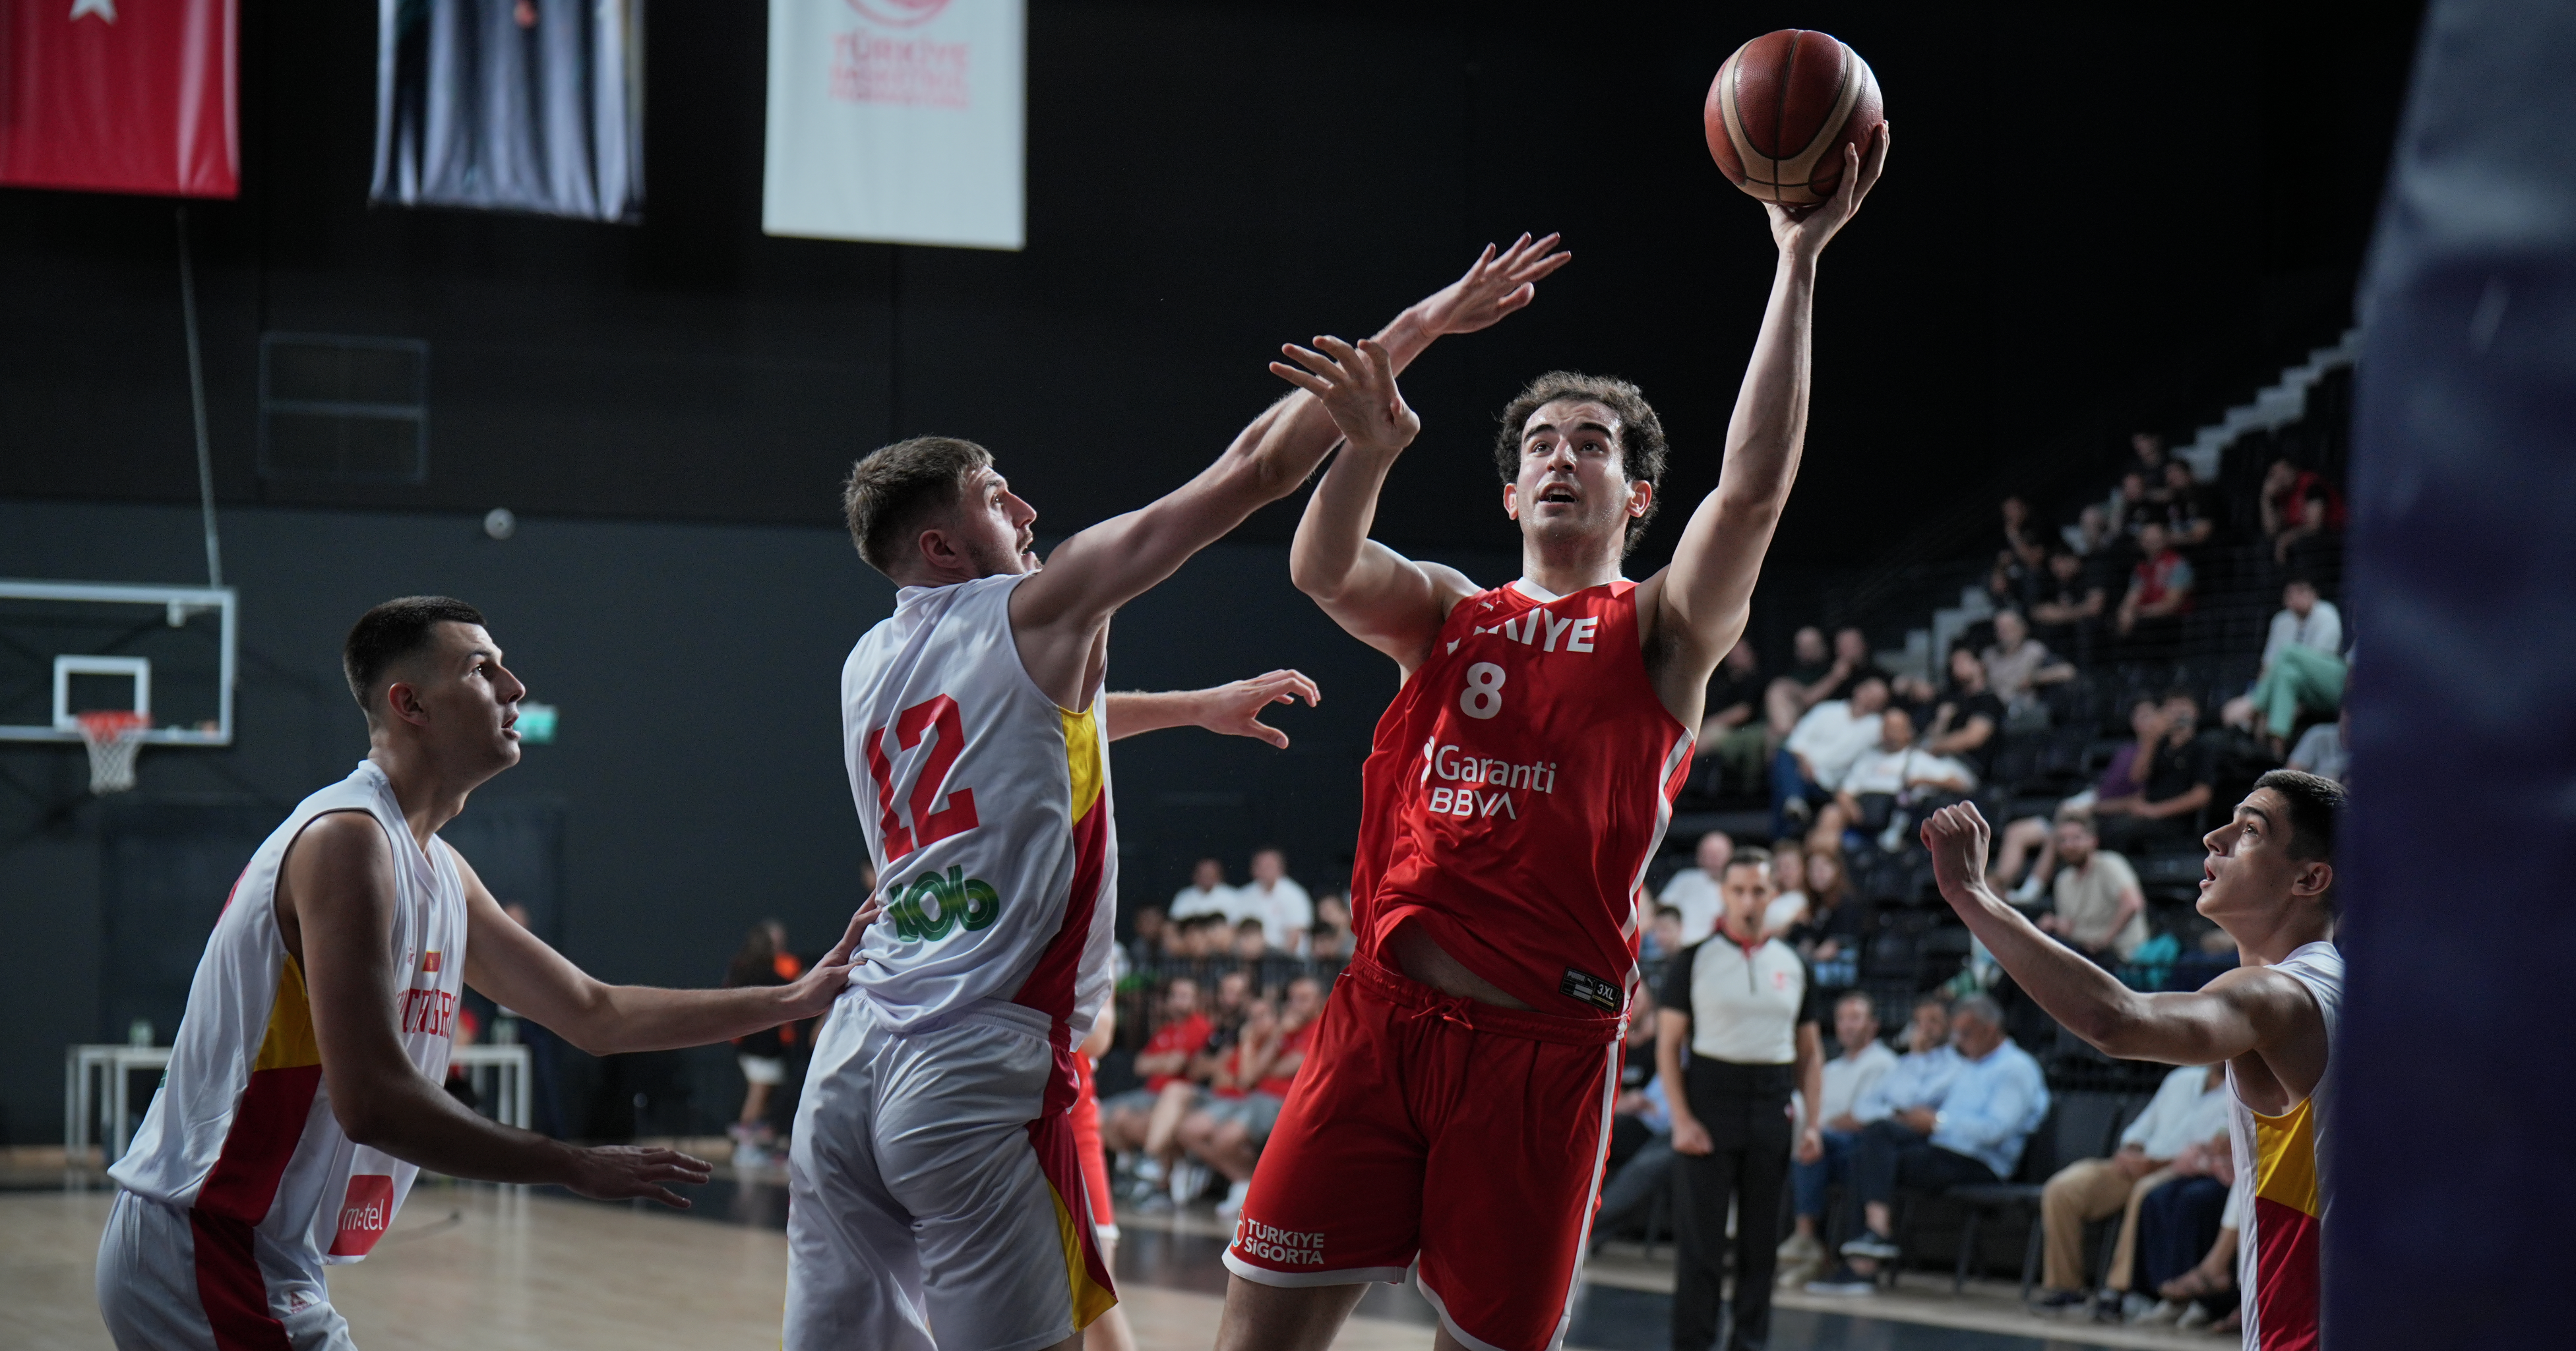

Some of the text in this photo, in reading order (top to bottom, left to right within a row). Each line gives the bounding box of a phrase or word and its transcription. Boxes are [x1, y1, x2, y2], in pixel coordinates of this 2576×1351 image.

[1459, 662, 1506, 720] 8
[866, 693, 979, 864] 12
[1435, 744, 1557, 794] Garanti
[1428, 787, 1516, 820] BBVA
[1597, 984, 1614, 1001] 3XL
[342, 1198, 384, 1230] m:tel
[1247, 1218, 1324, 1248] TÜRKİYE
[1244, 1236, 1324, 1265] SİGORTA
